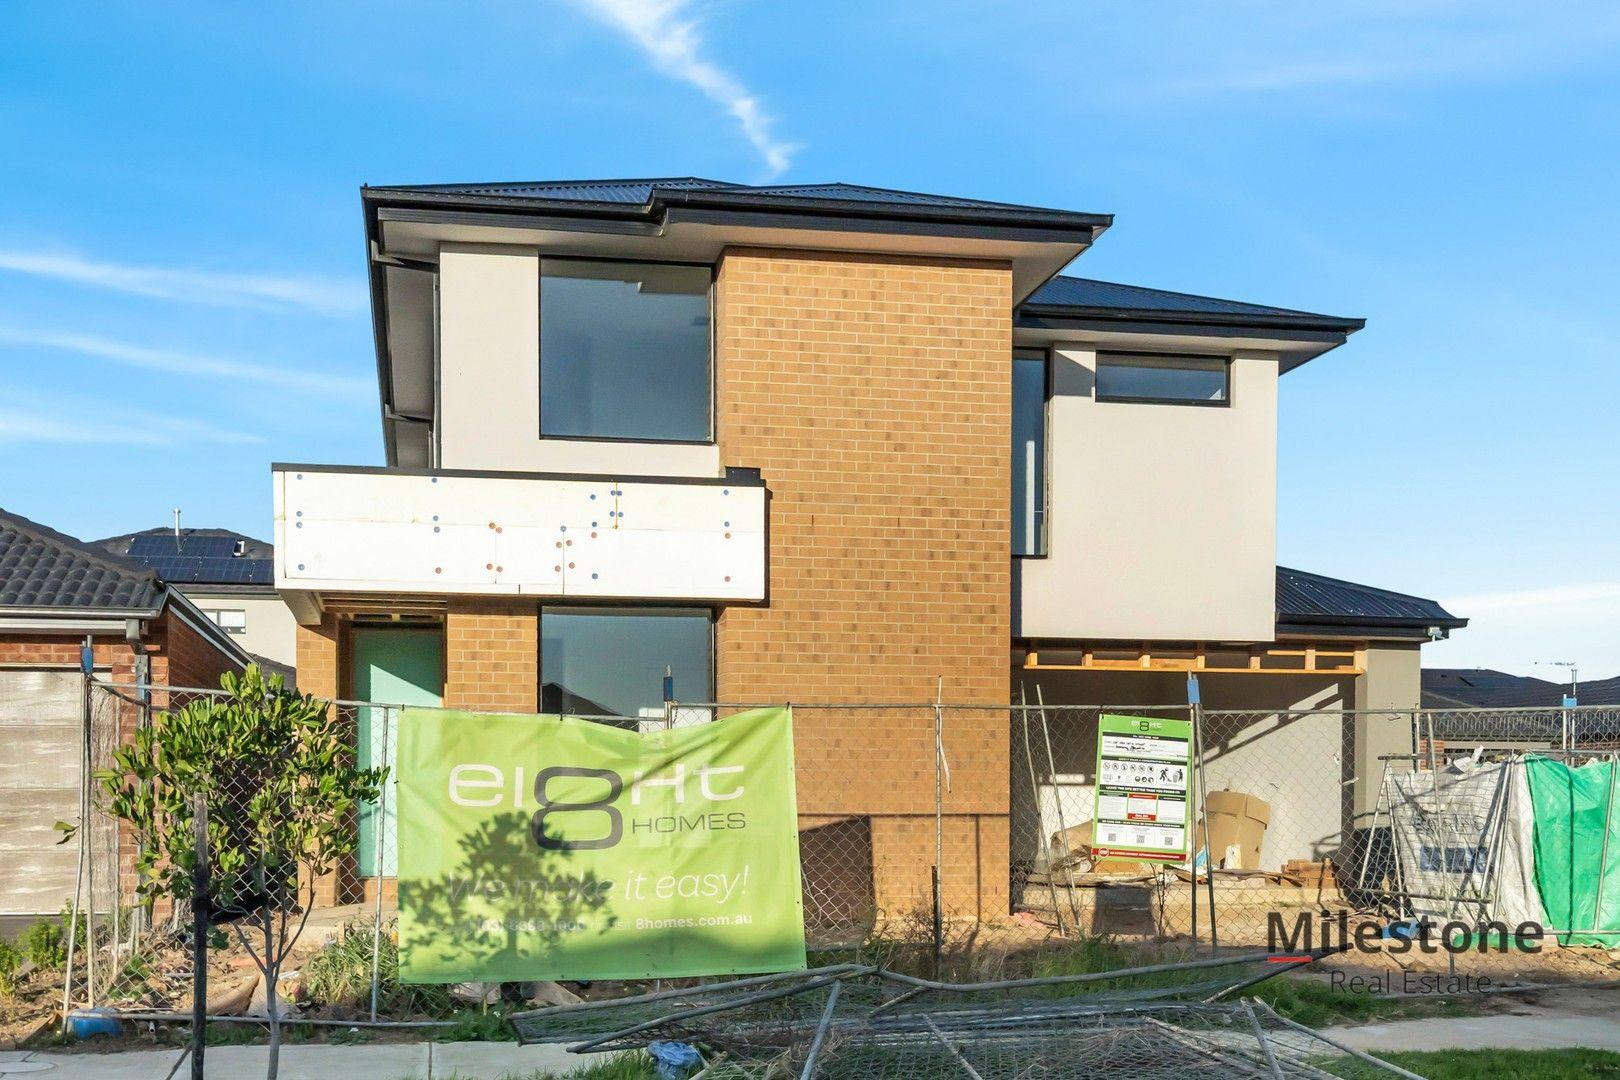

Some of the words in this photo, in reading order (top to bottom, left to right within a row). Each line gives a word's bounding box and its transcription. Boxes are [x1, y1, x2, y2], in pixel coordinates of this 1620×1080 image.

[632, 812, 746, 834] HOMES
[449, 871, 505, 902] We
[624, 870, 648, 901] it
[655, 864, 749, 905] easy!
[635, 914, 753, 930] 8homes.com.au
